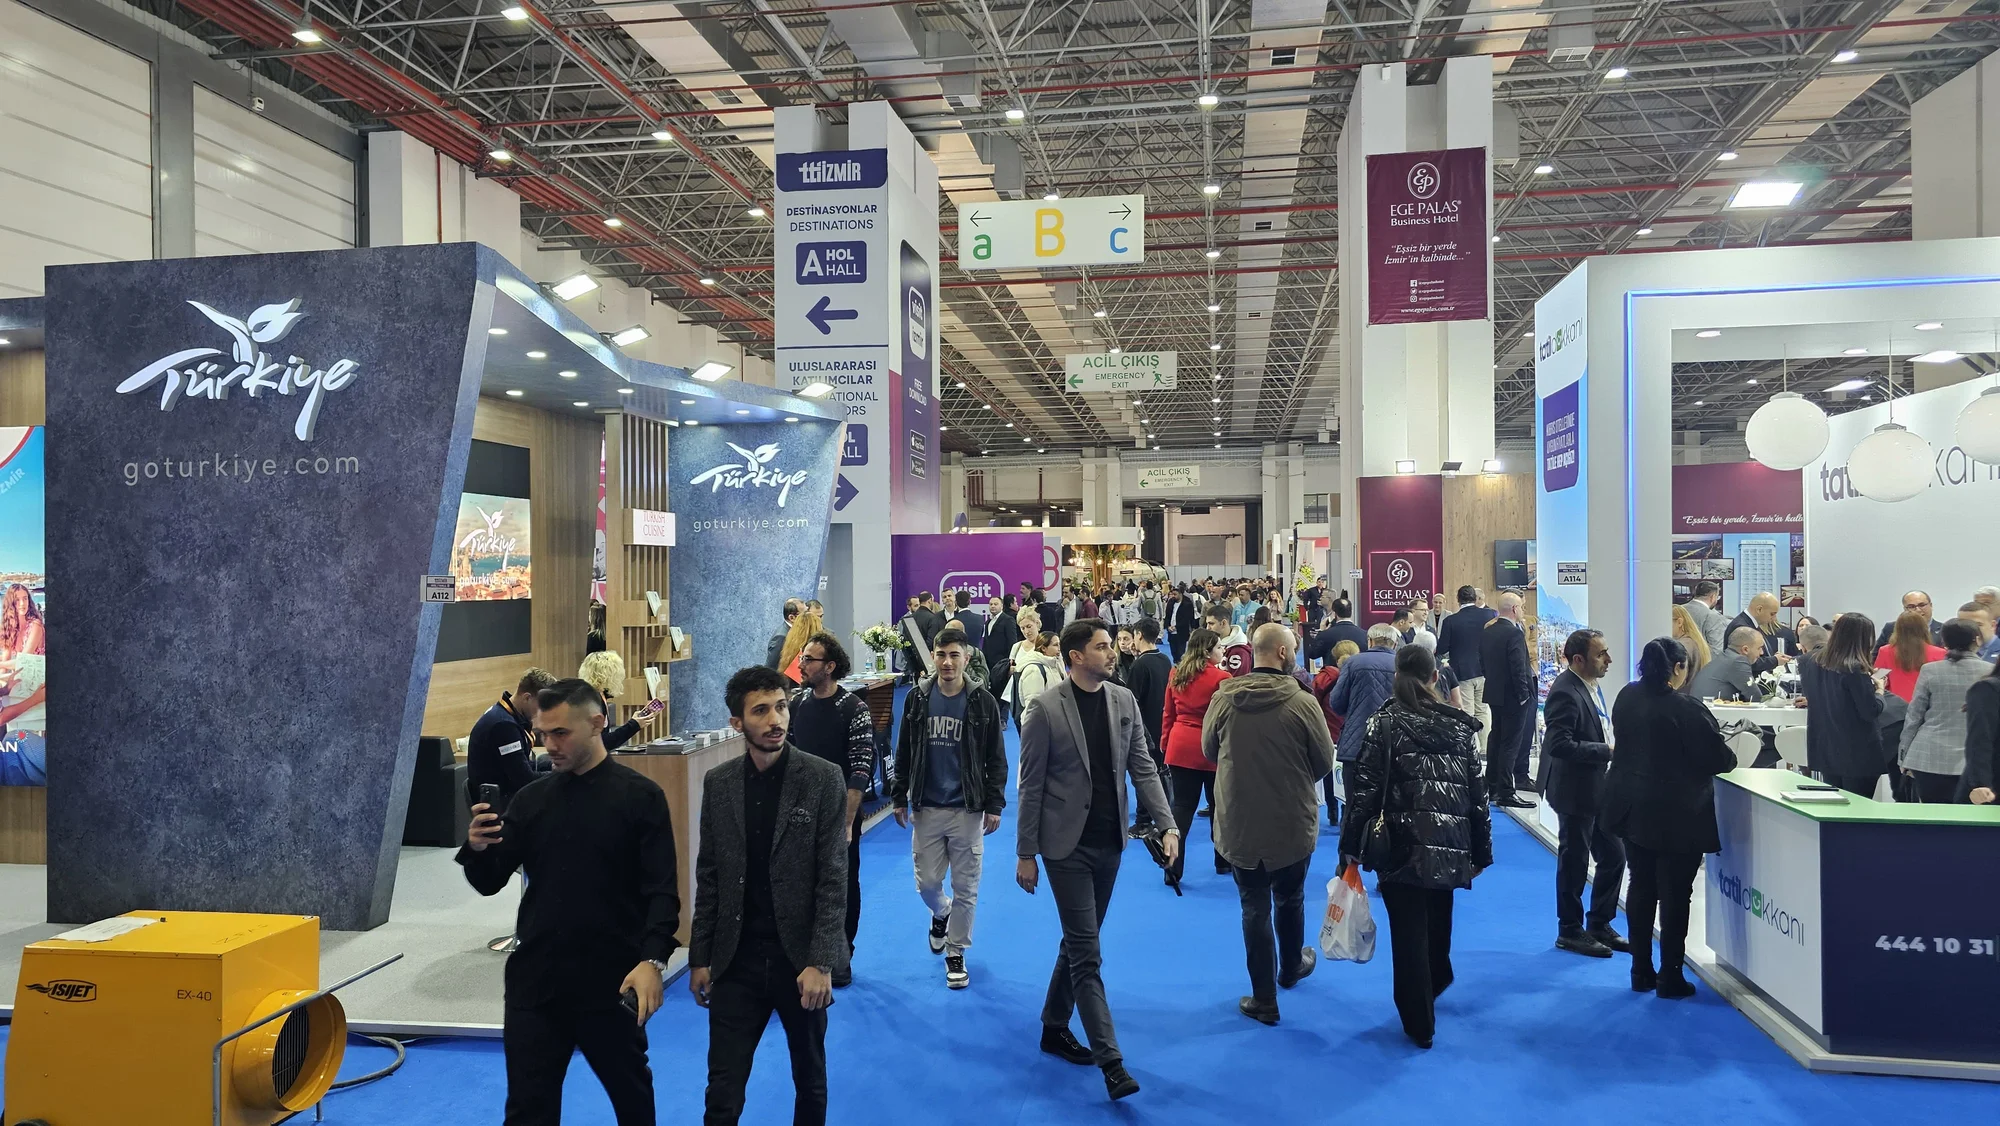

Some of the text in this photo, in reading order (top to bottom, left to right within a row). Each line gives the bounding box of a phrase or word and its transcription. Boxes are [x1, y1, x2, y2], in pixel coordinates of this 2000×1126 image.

[786, 203, 878, 217] DESTİNASYONLAR
[1390, 203, 1415, 217] EGE
[790, 219, 874, 232] DESTINATIONS
[1391, 213, 1459, 227] Business Hotel
[1034, 207, 1066, 258] B
[1419, 243, 1432, 252] bir
[1433, 241, 1457, 253] yerde
[825, 248, 855, 261] HOL
[801, 249, 824, 277] A
[826, 264, 861, 276] HALL
[788, 360, 877, 372] ULUSLARARASI
[1082, 353, 1160, 370] ACİL ÇIKIŞ
[1095, 372, 1146, 380] EMERGENCY
[1111, 381, 1129, 389] EXIT
[115, 345, 361, 442] Türkiye
[123, 453, 360, 487] goturkiye.com
[0, 468, 26, 495] ZMİR
[689, 463, 808, 508] Türkiye
[693, 517, 809, 533] goturkiye.com
[1710, 515, 1722, 524] bir
[459, 529, 516, 573] Türkiye
[459, 573, 518, 588] goturkiye.com
[431, 591, 450, 600] A112
[1374, 589, 1393, 600] EGE
[927, 715, 963, 742] AMPU
[1874, 934, 1994, 955] 444 10 31
[176, 989, 212, 1002] EX-40
